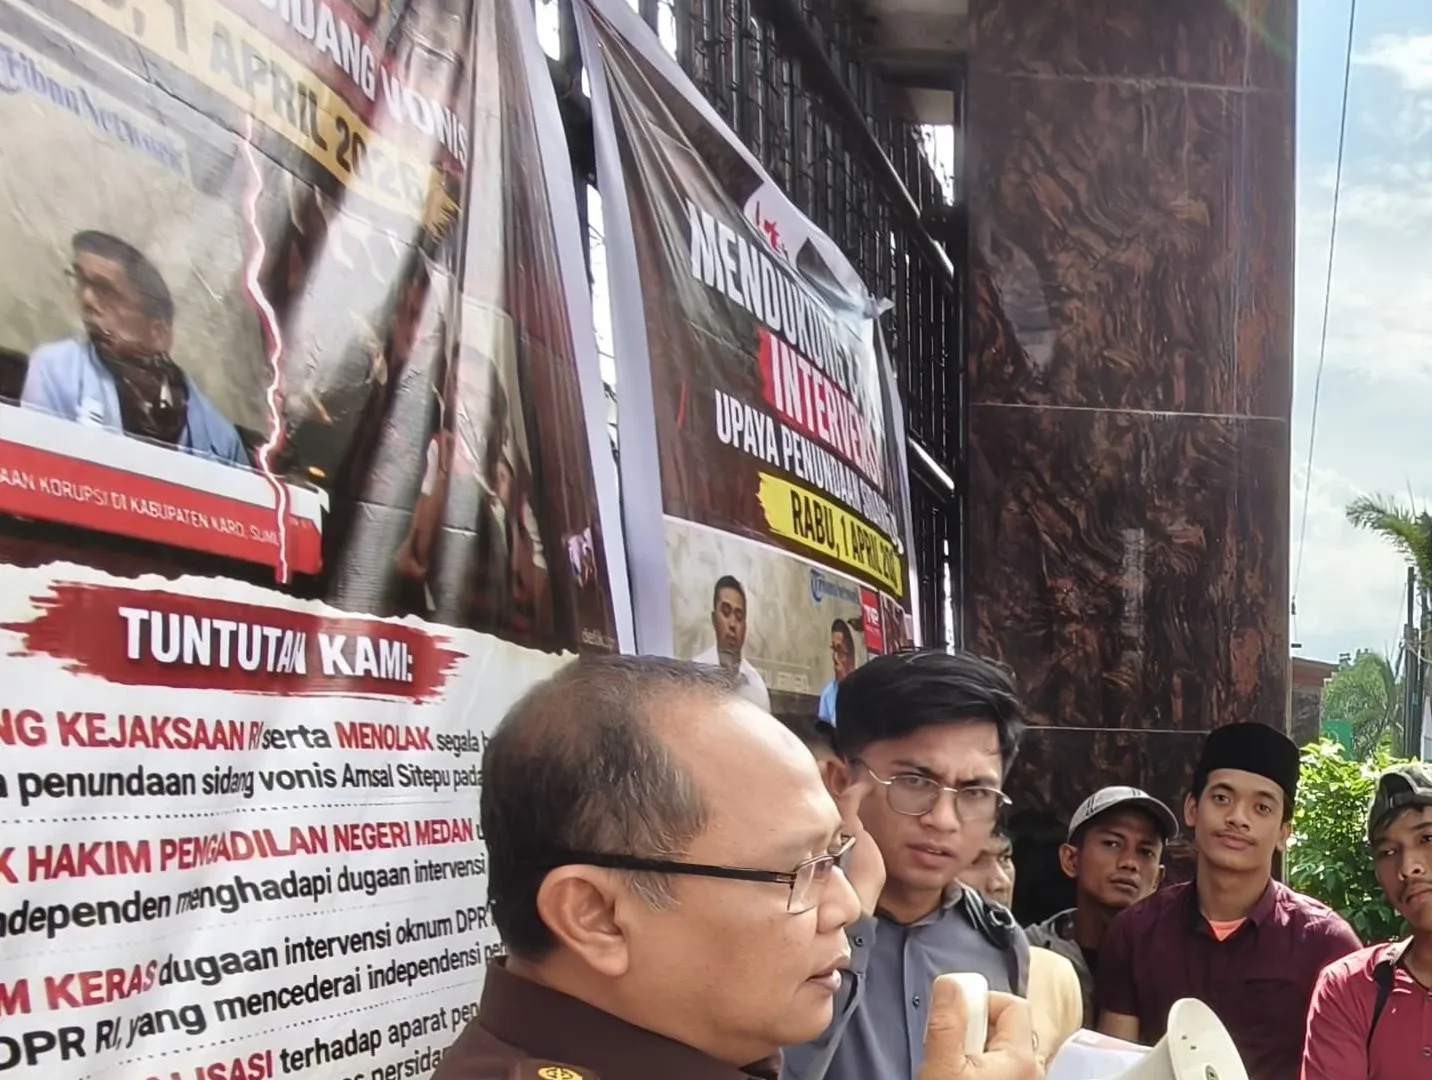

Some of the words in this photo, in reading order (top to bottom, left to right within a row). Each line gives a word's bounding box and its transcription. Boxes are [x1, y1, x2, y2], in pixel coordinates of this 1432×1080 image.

[210, 20, 328, 152] APRIL
[380, 62, 468, 169] VONIS
[714, 388, 780, 467] UPAYA
[39, 476, 109, 507] KORUPSI
[130, 497, 209, 530] KABUPATEN
[790, 489, 840, 558] RABU,
[840, 515, 849, 557] 1
[850, 520, 883, 576] APRIL
[118, 606, 306, 675] TUNTUTAN
[316, 633, 414, 684] KAMI:
[56, 709, 245, 751] KEJAKSAAN
[261, 724, 332, 750] serta
[334, 720, 433, 752] MENOLAK
[435, 729, 481, 758] segala
[18, 763, 197, 807] penundaan
[202, 764, 255, 799] sidang
[259, 762, 337, 792] vonis
[341, 763, 394, 789] Amsal
[397, 761, 451, 793] Sitepu
[28, 838, 152, 883] HAKIM
[160, 824, 329, 872] PENGADILAN
[333, 820, 412, 854] NEGERI
[415, 817, 473, 845] MEDAN
[175, 865, 333, 915] menghadapi
[338, 862, 411, 896] dugaan
[414, 853, 486, 882] intervensi
[44, 962, 158, 1010] KERAS
[159, 943, 279, 988] dugaan
[284, 919, 393, 967] intervensi
[395, 916, 453, 946] oknum
[455, 906, 489, 935] DPR
[125, 1000, 208, 1049] yang
[214, 967, 363, 1023] mencederai
[367, 941, 482, 993] independensi
[279, 1028, 383, 1074] terhadap
[388, 1006, 448, 1046] aparat
